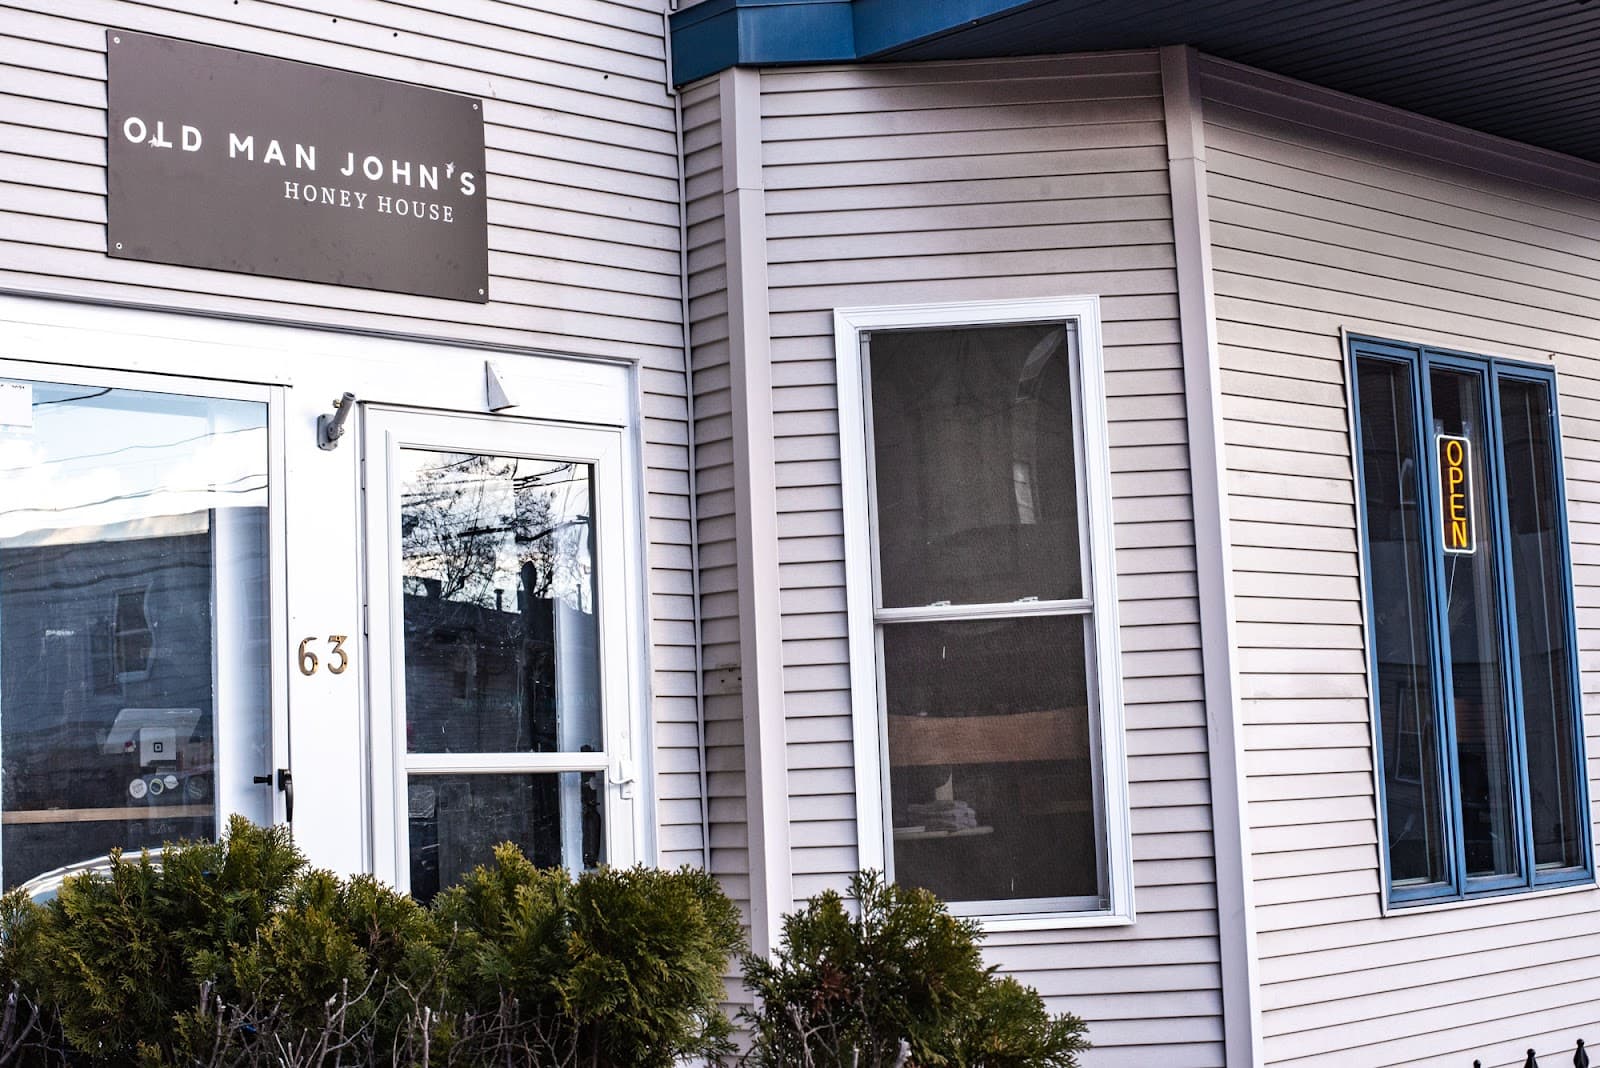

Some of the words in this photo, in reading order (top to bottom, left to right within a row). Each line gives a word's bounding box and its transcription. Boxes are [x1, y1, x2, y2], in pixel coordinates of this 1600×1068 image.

[123, 116, 203, 153] OLD
[228, 132, 316, 172] MAN
[340, 151, 476, 196] JOHN'S
[283, 181, 368, 210] HONEY
[377, 196, 455, 223] HOUSE
[1446, 440, 1468, 547] OPEN
[298, 635, 348, 676] 63
